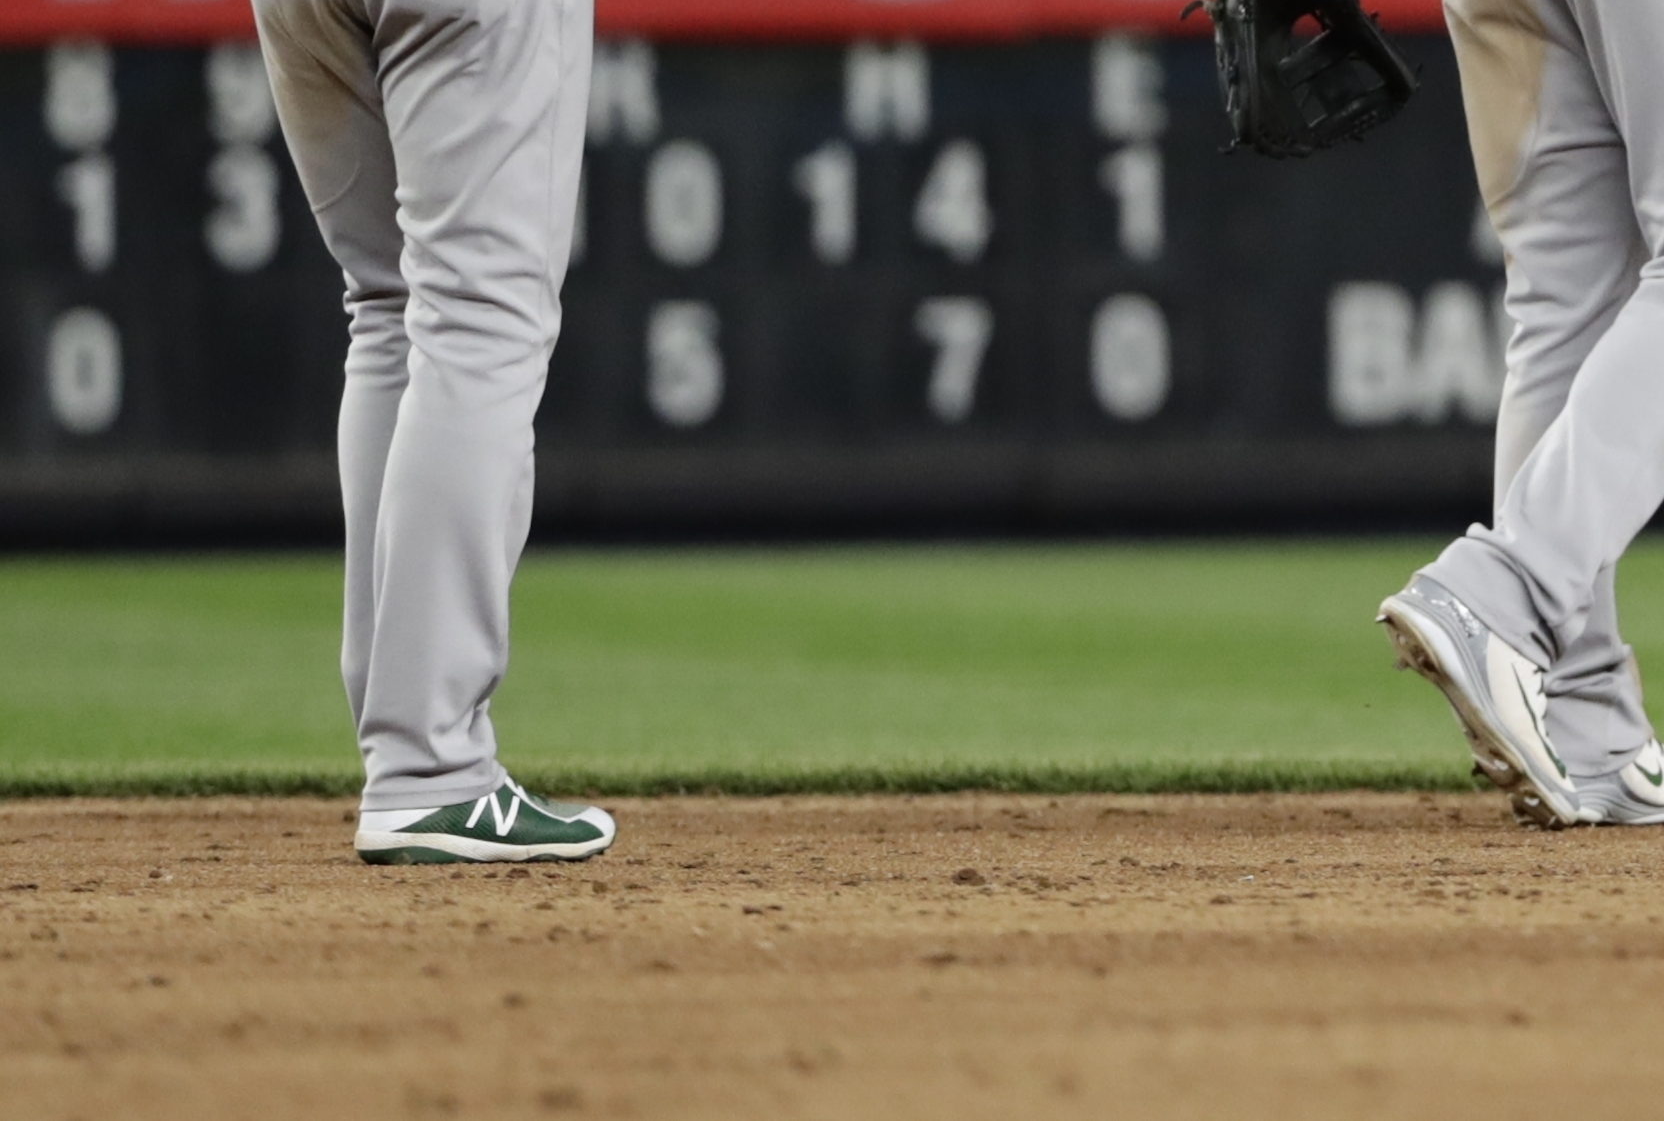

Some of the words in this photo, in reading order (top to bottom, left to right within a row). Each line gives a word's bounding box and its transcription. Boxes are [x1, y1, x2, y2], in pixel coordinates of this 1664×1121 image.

[61, 149, 118, 273] 1
[206, 141, 282, 273] 3
[1100, 139, 1165, 265] 1
[47, 307, 122, 434] 0
[911, 292, 995, 424] 7
[1089, 290, 1172, 422] 0
